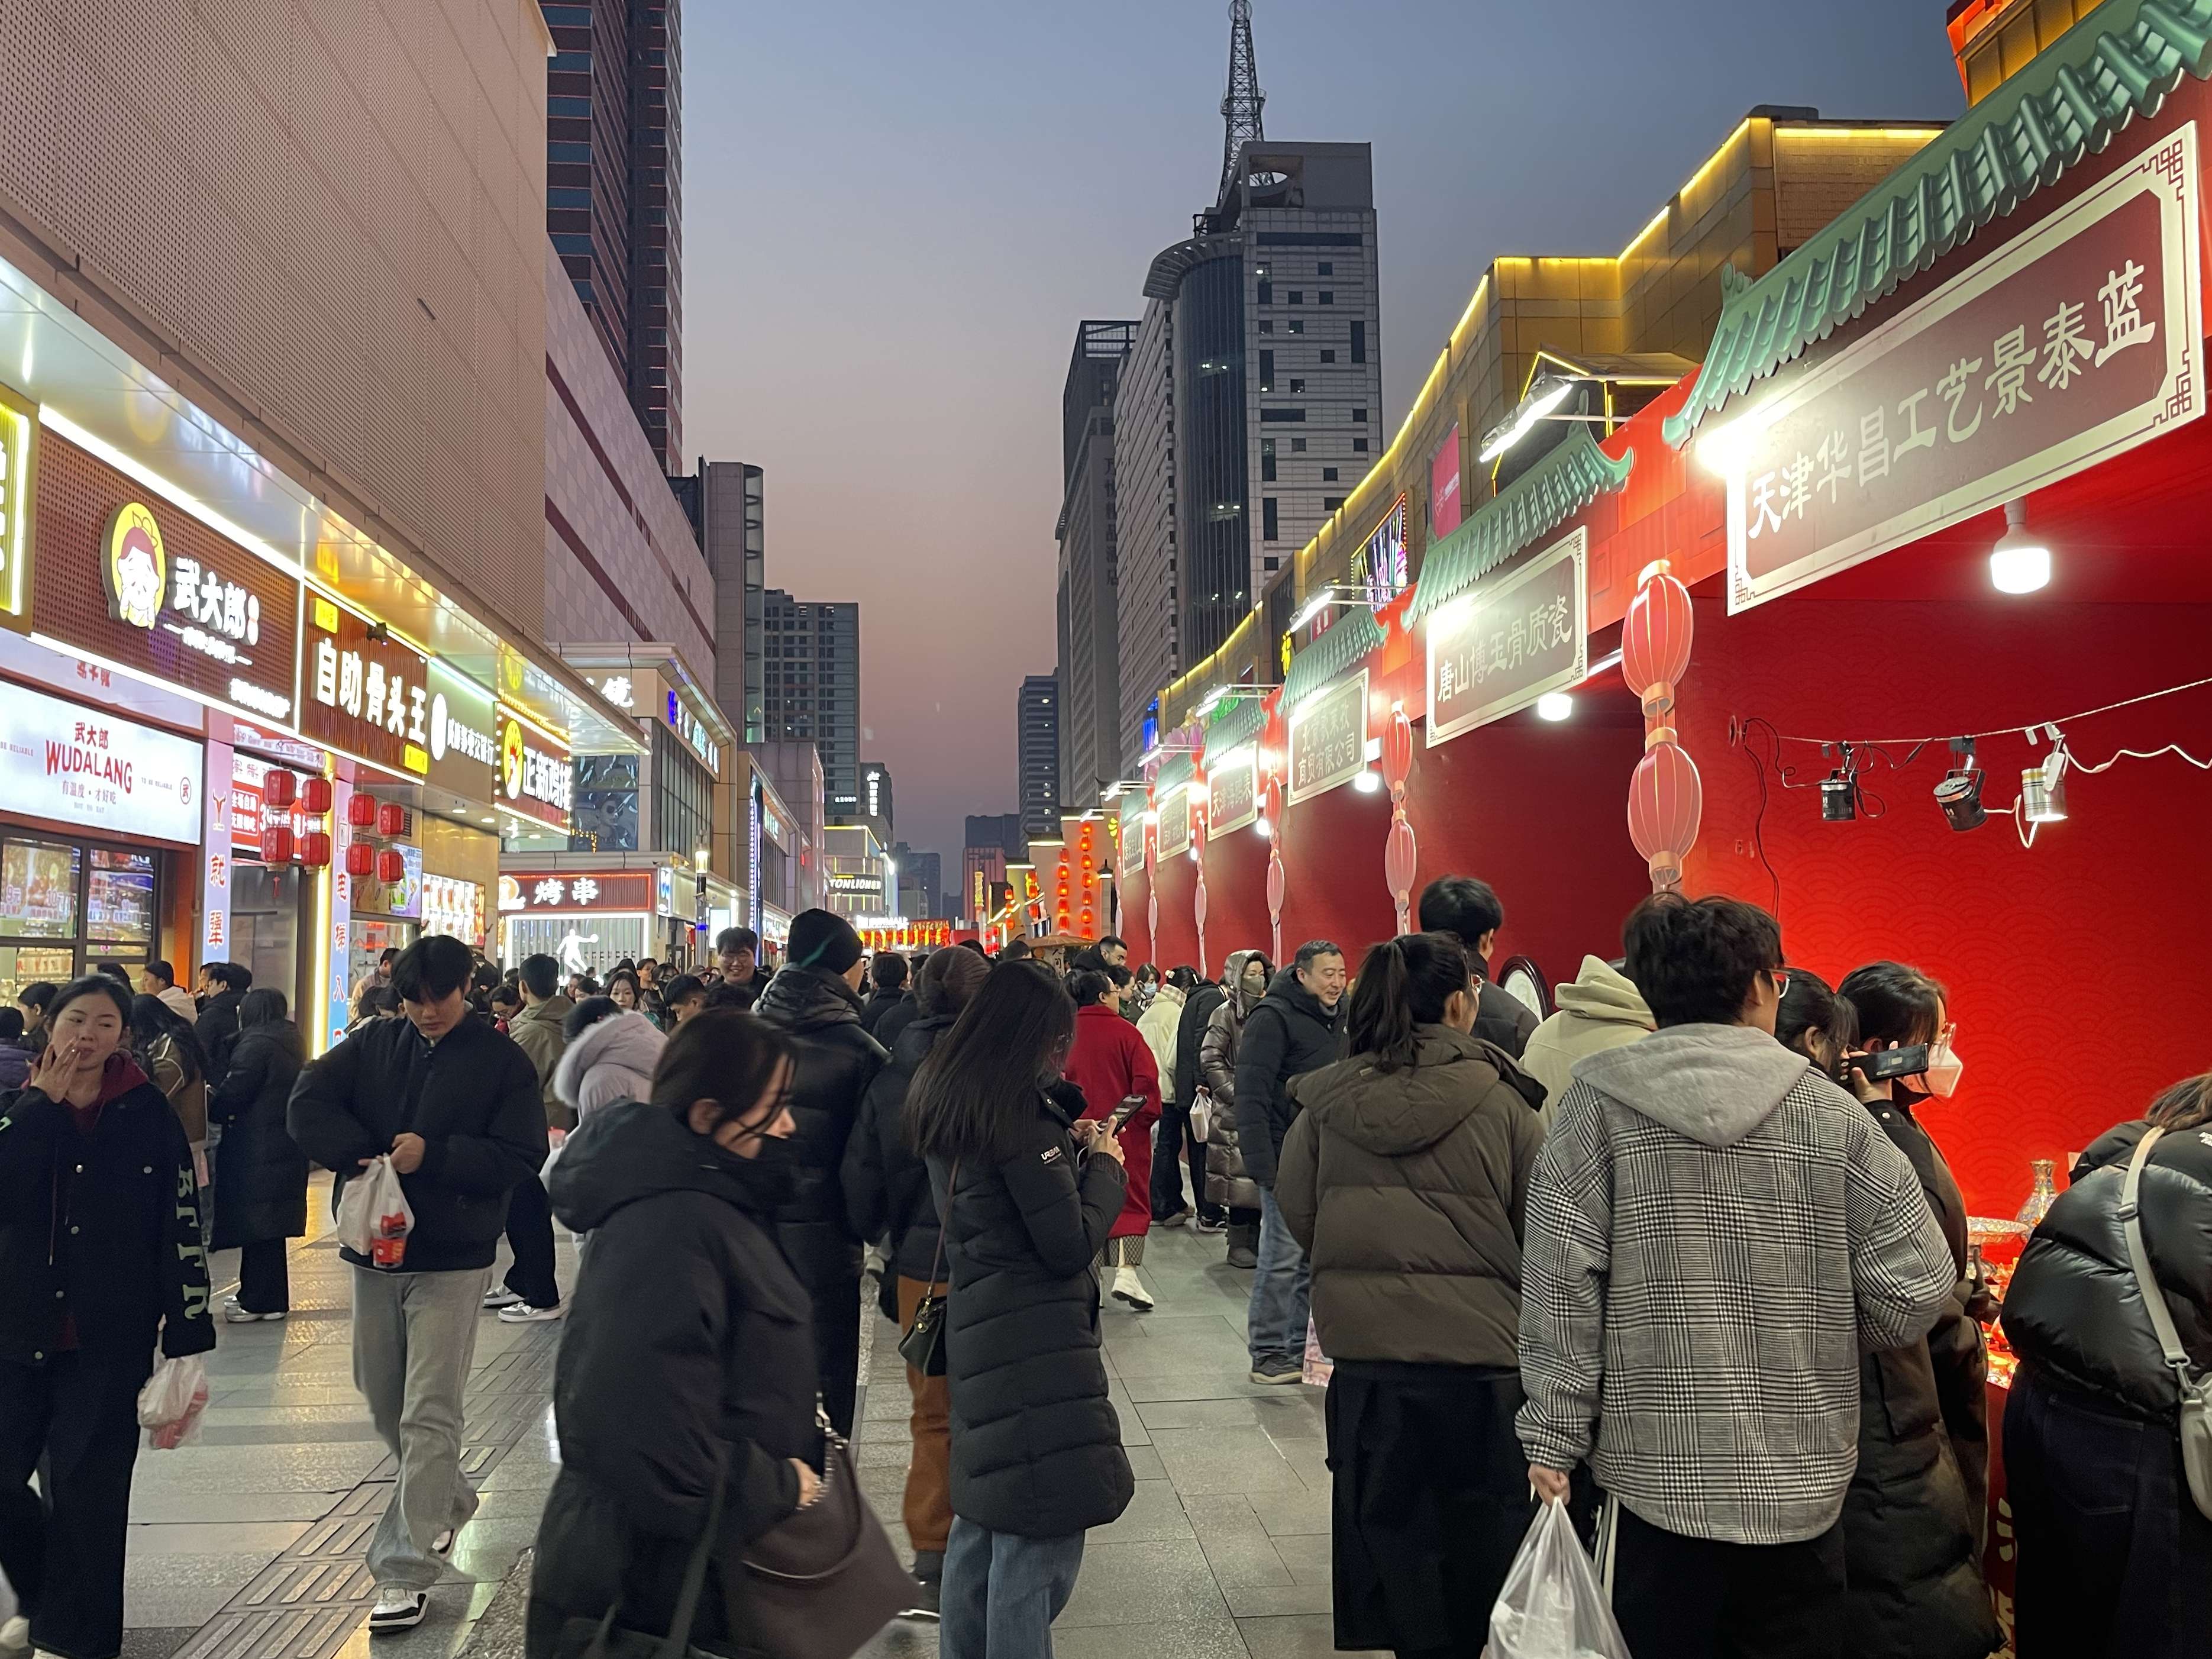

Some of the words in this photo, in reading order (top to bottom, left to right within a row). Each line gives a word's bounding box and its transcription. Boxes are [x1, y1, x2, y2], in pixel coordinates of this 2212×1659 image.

[1748, 260, 2155, 538] 天津华昌工艺景泰蓝
[174, 557, 247, 639] 武大郎
[1438, 595, 1572, 702] 唐山博玉骨质瓷
[317, 637, 426, 745] 自助骨头王
[46, 740, 133, 794] WUDALANG
[74, 722, 109, 750] 武大郎
[534, 877, 599, 906] 烤串
[829, 879, 873, 890] TONLION
